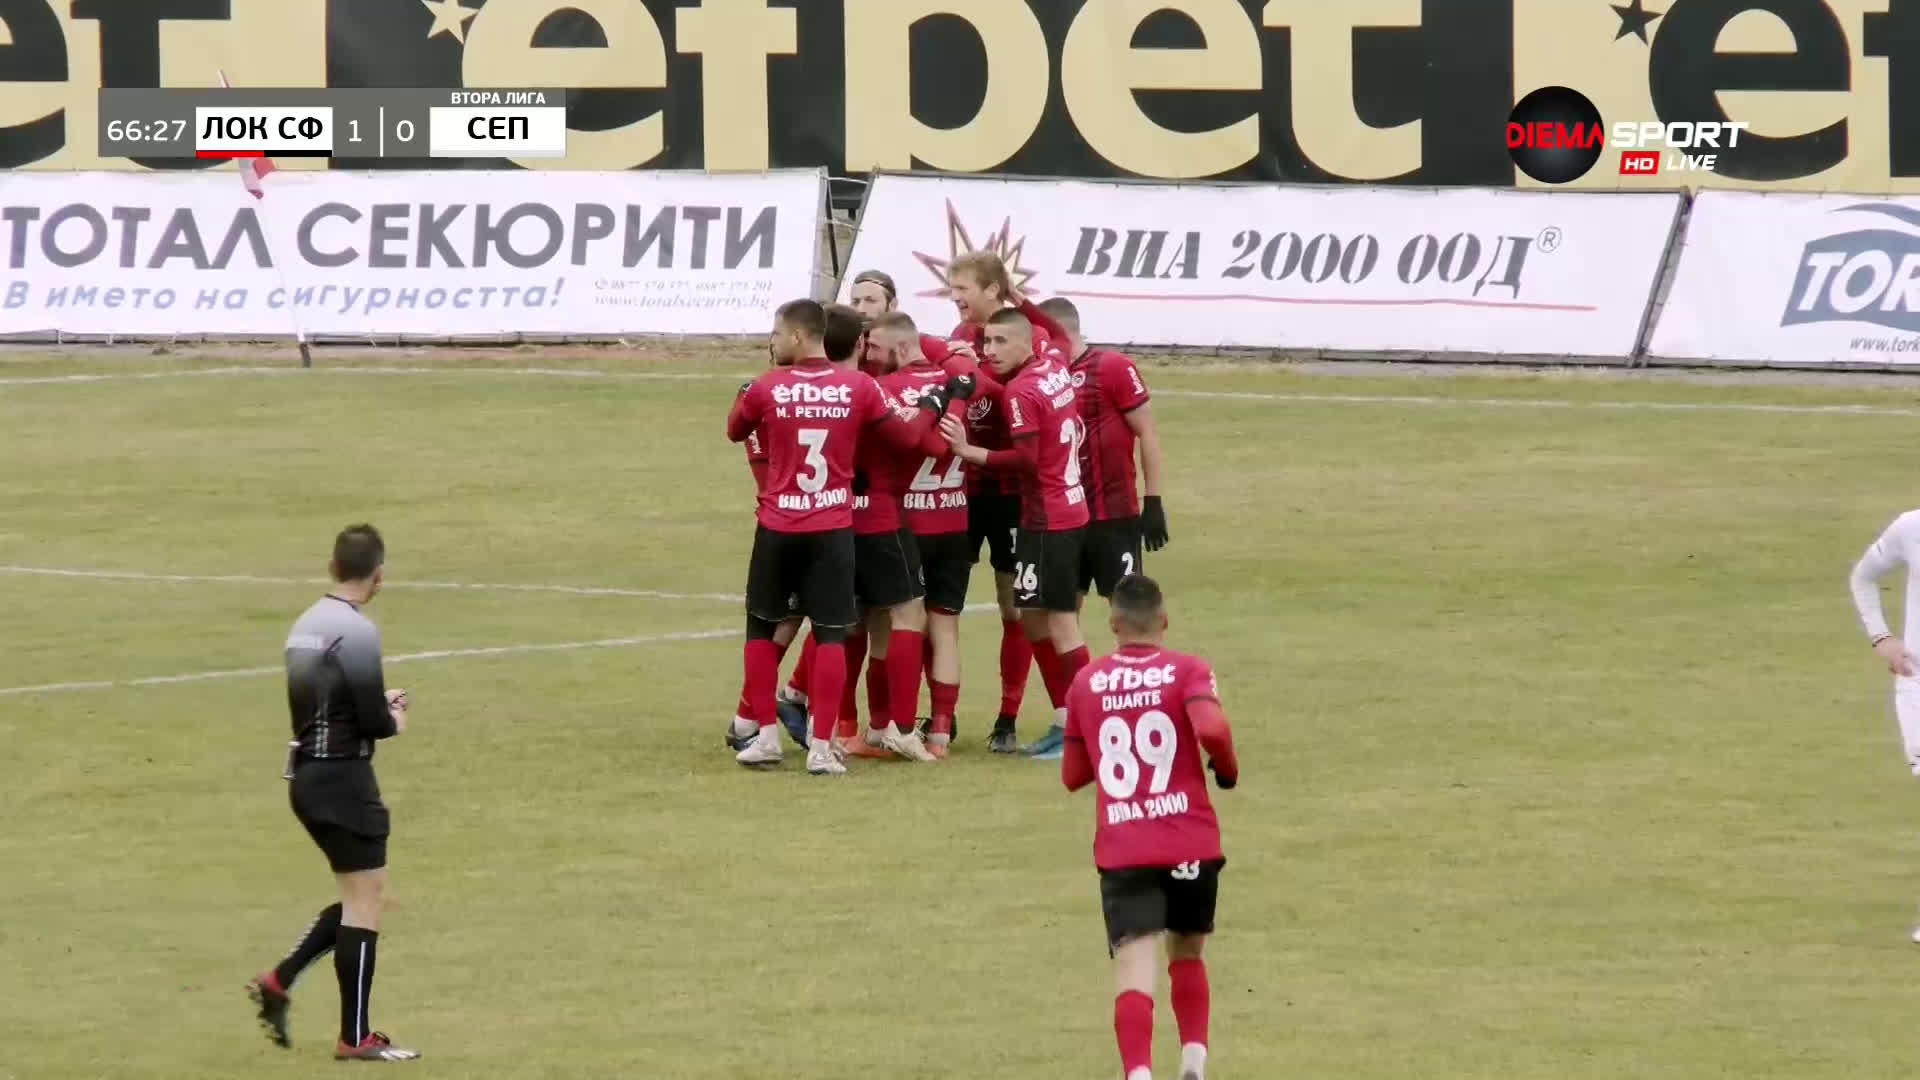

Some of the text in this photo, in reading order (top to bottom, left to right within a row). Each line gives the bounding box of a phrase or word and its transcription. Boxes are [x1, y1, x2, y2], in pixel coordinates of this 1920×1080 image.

[461, 0, 1422, 180] efbet
[2, 201, 777, 270] ТОТАЛ СЕКЮРИТИ
[1066, 227, 1201, 280] ВИА
[1221, 230, 1379, 284] 2000
[4, 281, 30, 309] В
[45, 285, 177, 309] името
[195, 288, 249, 309] на
[266, 277, 565, 315] сигурността!
[771, 383, 853, 404] efbet
[776, 407, 851, 418] M. PETKOV
[796, 428, 829, 493] 3
[814, 488, 848, 508] 2000
[1089, 663, 1177, 693] efbet
[1102, 689, 1162, 712] DUARTE
[1098, 709, 1178, 799] 89
[1145, 792, 1189, 819] 2000
